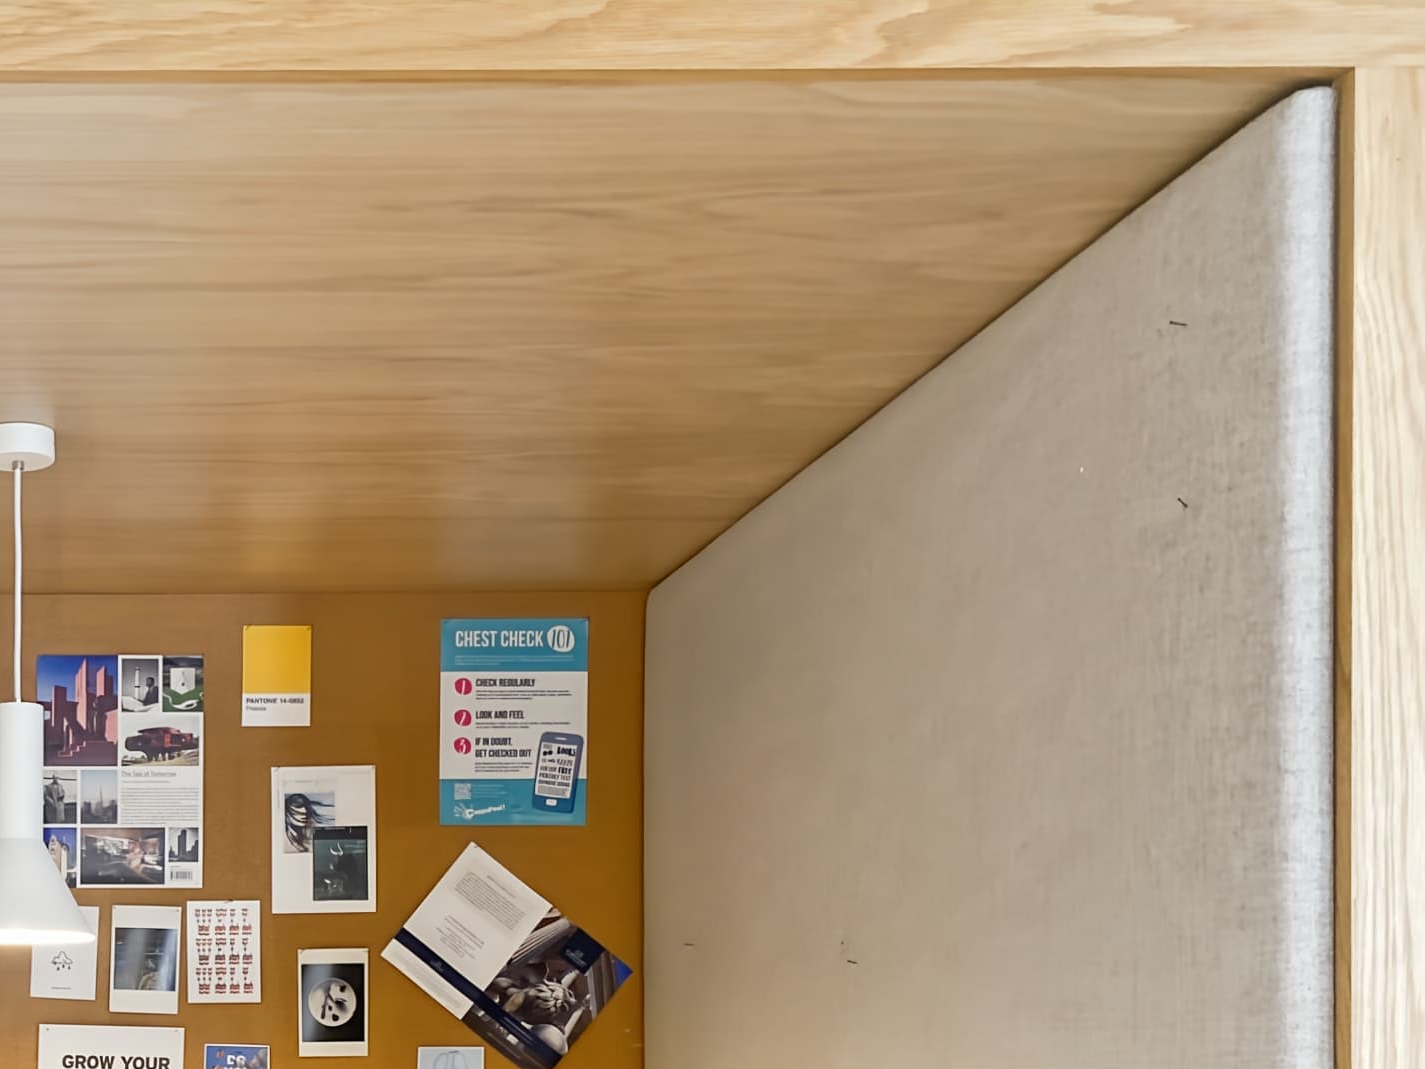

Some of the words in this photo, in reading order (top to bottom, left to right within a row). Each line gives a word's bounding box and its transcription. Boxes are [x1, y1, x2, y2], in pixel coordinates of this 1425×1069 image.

[455, 630, 497, 647] CHEST
[501, 630, 544, 647] CHECK
[551, 629, 571, 649] 101
[476, 679, 497, 687] CHECK
[499, 679, 535, 687] REGULARLY
[475, 711, 492, 719] LOOK
[494, 711, 507, 719] AND
[509, 711, 525, 719] FEEL
[475, 738, 481, 746] IF
[483, 738, 489, 746] IN
[475, 750, 487, 758] GET
[489, 750, 517, 758] CHECKED
[519, 750, 532, 758] OUT
[62, 1055, 115, 1069] GROW
[227, 1055, 247, 1064] DO
